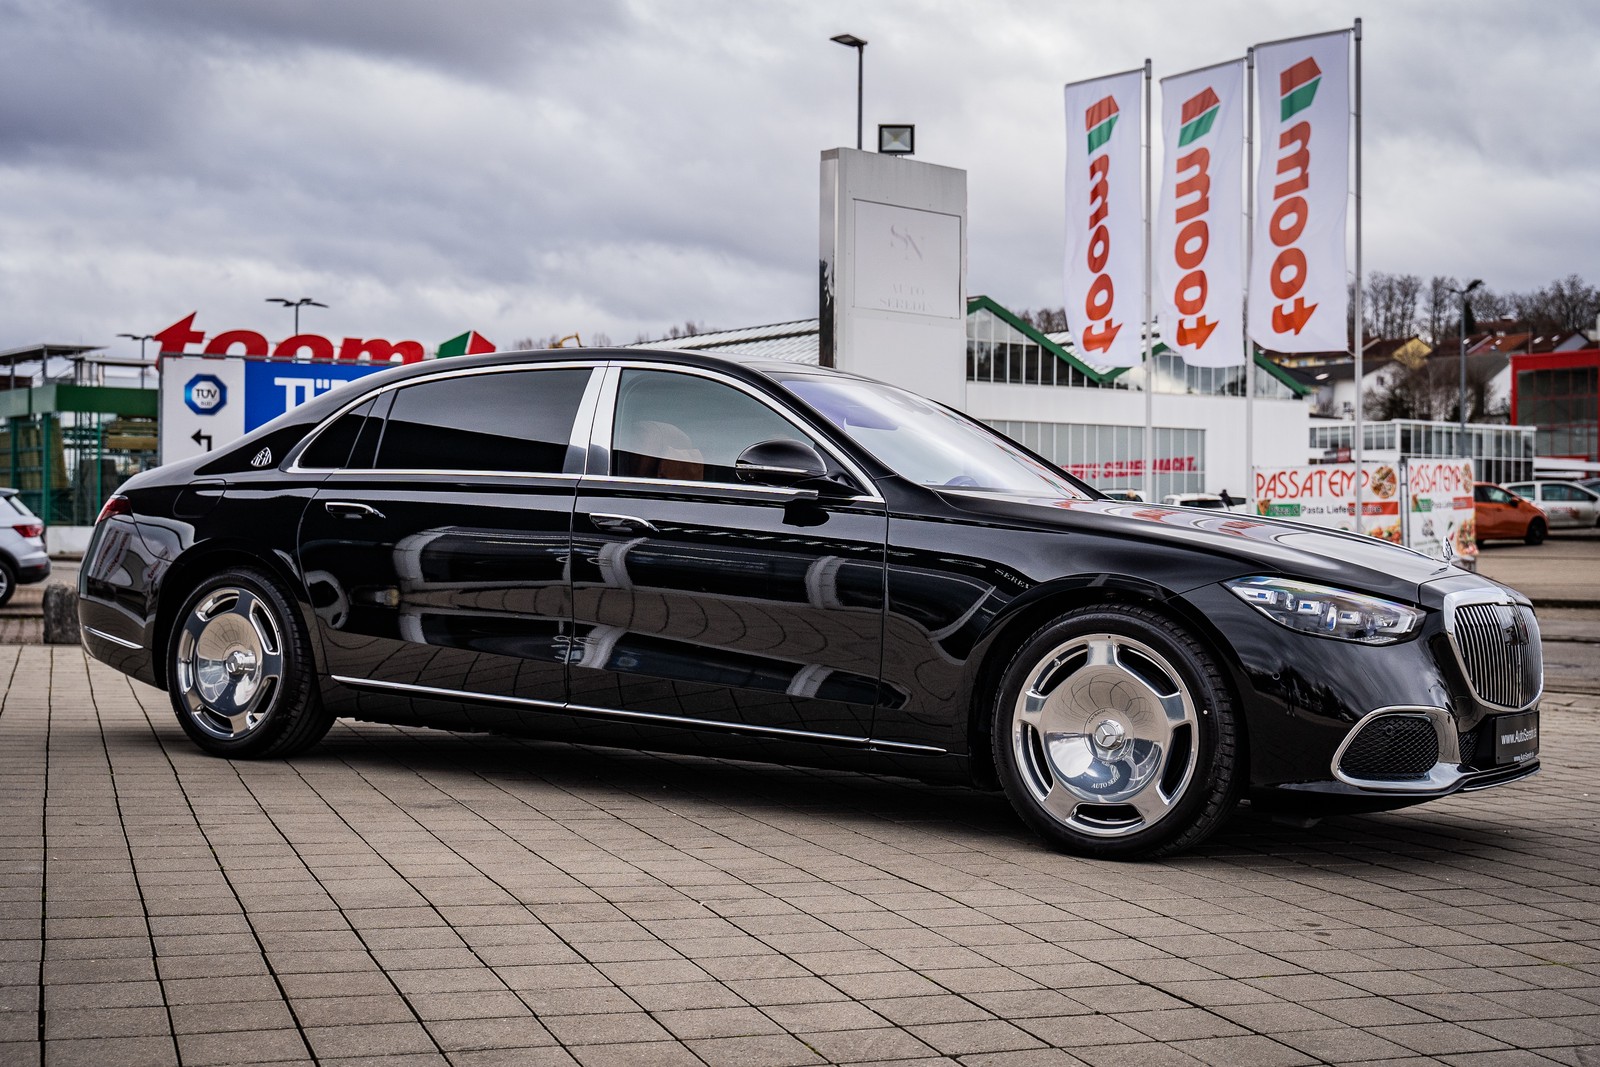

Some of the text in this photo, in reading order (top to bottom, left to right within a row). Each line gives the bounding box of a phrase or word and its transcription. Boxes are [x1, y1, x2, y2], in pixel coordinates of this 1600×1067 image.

[1082, 154, 1123, 353] toom
[1174, 147, 1220, 350] toom
[1269, 120, 1319, 336] toom
[1301, 503, 1325, 515] Pasta
